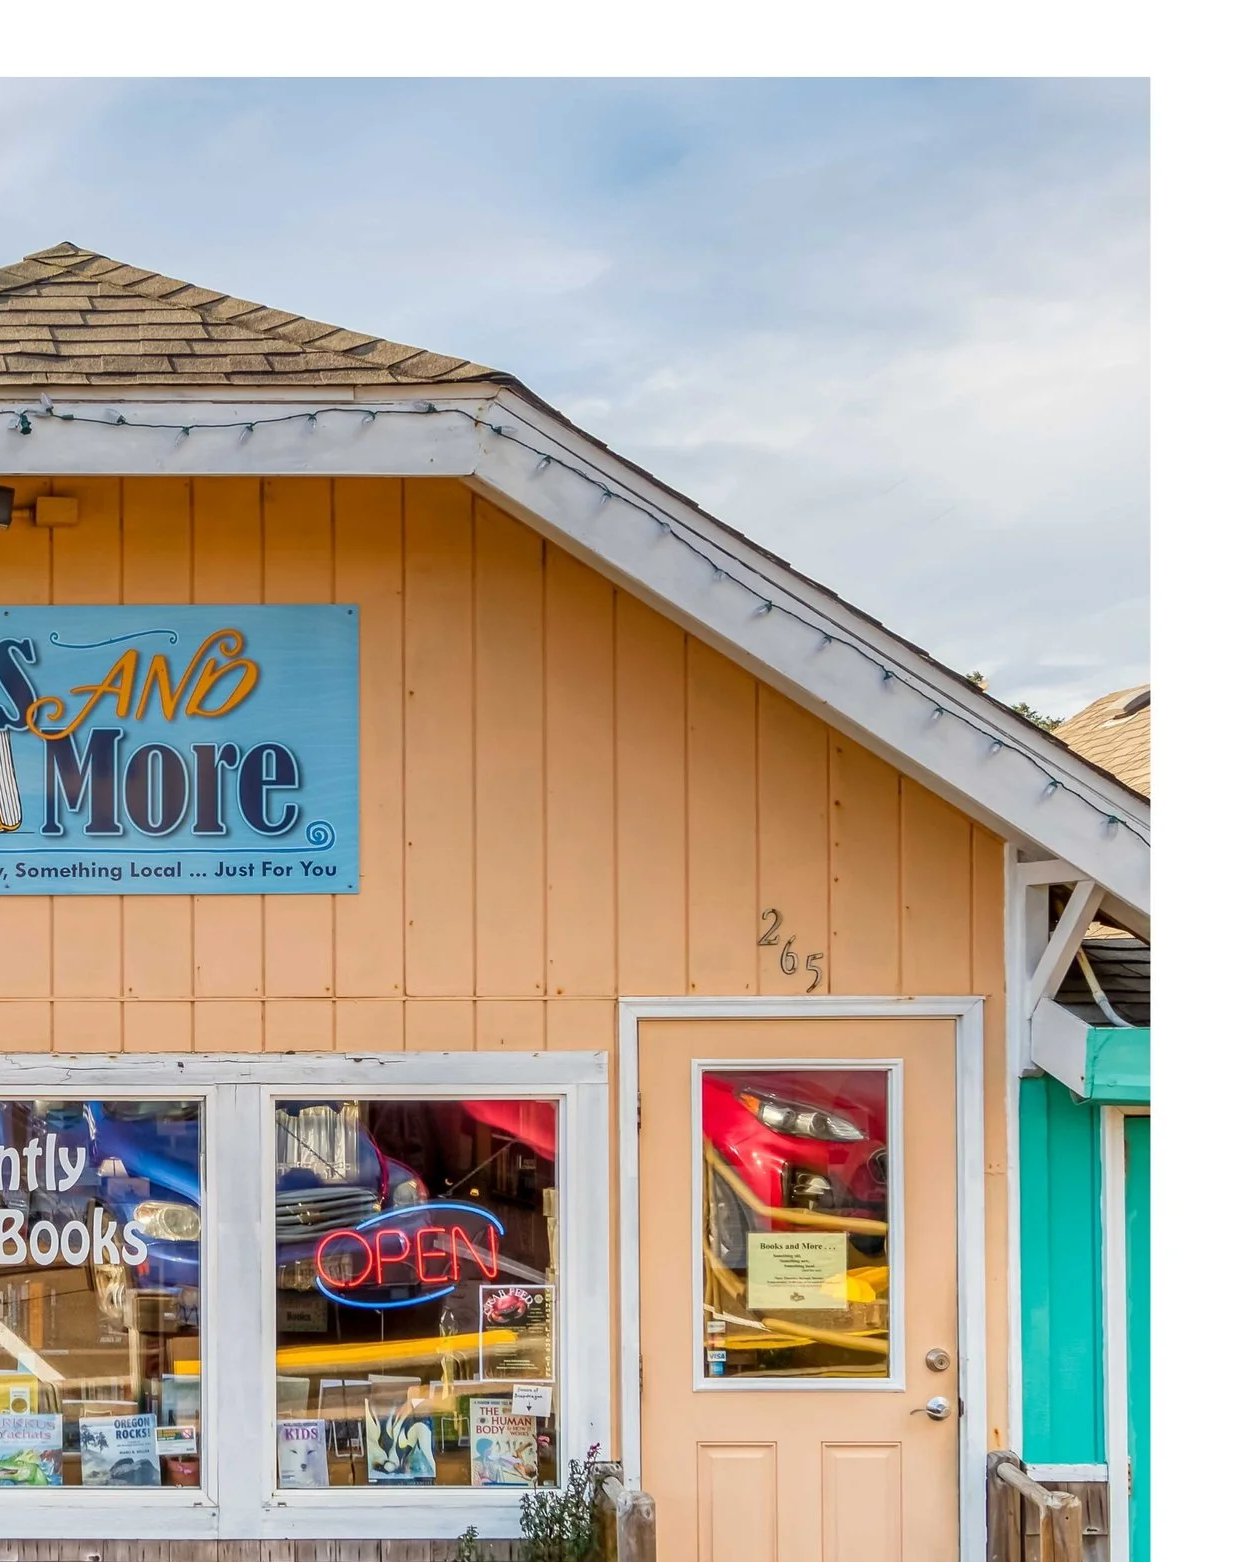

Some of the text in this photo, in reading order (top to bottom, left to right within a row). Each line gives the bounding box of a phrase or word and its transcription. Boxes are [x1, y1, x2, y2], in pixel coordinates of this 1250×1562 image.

[25, 628, 260, 741] AND
[40, 727, 300, 838] More
[15, 861, 122, 882] Something
[130, 861, 182, 879] Local
[214, 861, 255, 879] Just
[261, 861, 294, 878] For
[299, 860, 338, 878] You
[757, 908, 824, 993] 265
[760, 1242, 783, 1250] Books
[785, 1242, 800, 1250] and
[801, 1242, 823, 1250] More
[314, 1223, 499, 1288] OPEN
[509, 1288, 534, 1309] FEED
[479, 1406, 500, 1416] THE
[113, 1417, 150, 1429] OREGON
[491, 1416, 532, 1426] HUMAN
[115, 1428, 151, 1440] ROCKS!
[284, 1427, 319, 1441] KIDS
[476, 1425, 505, 1435] BODY
